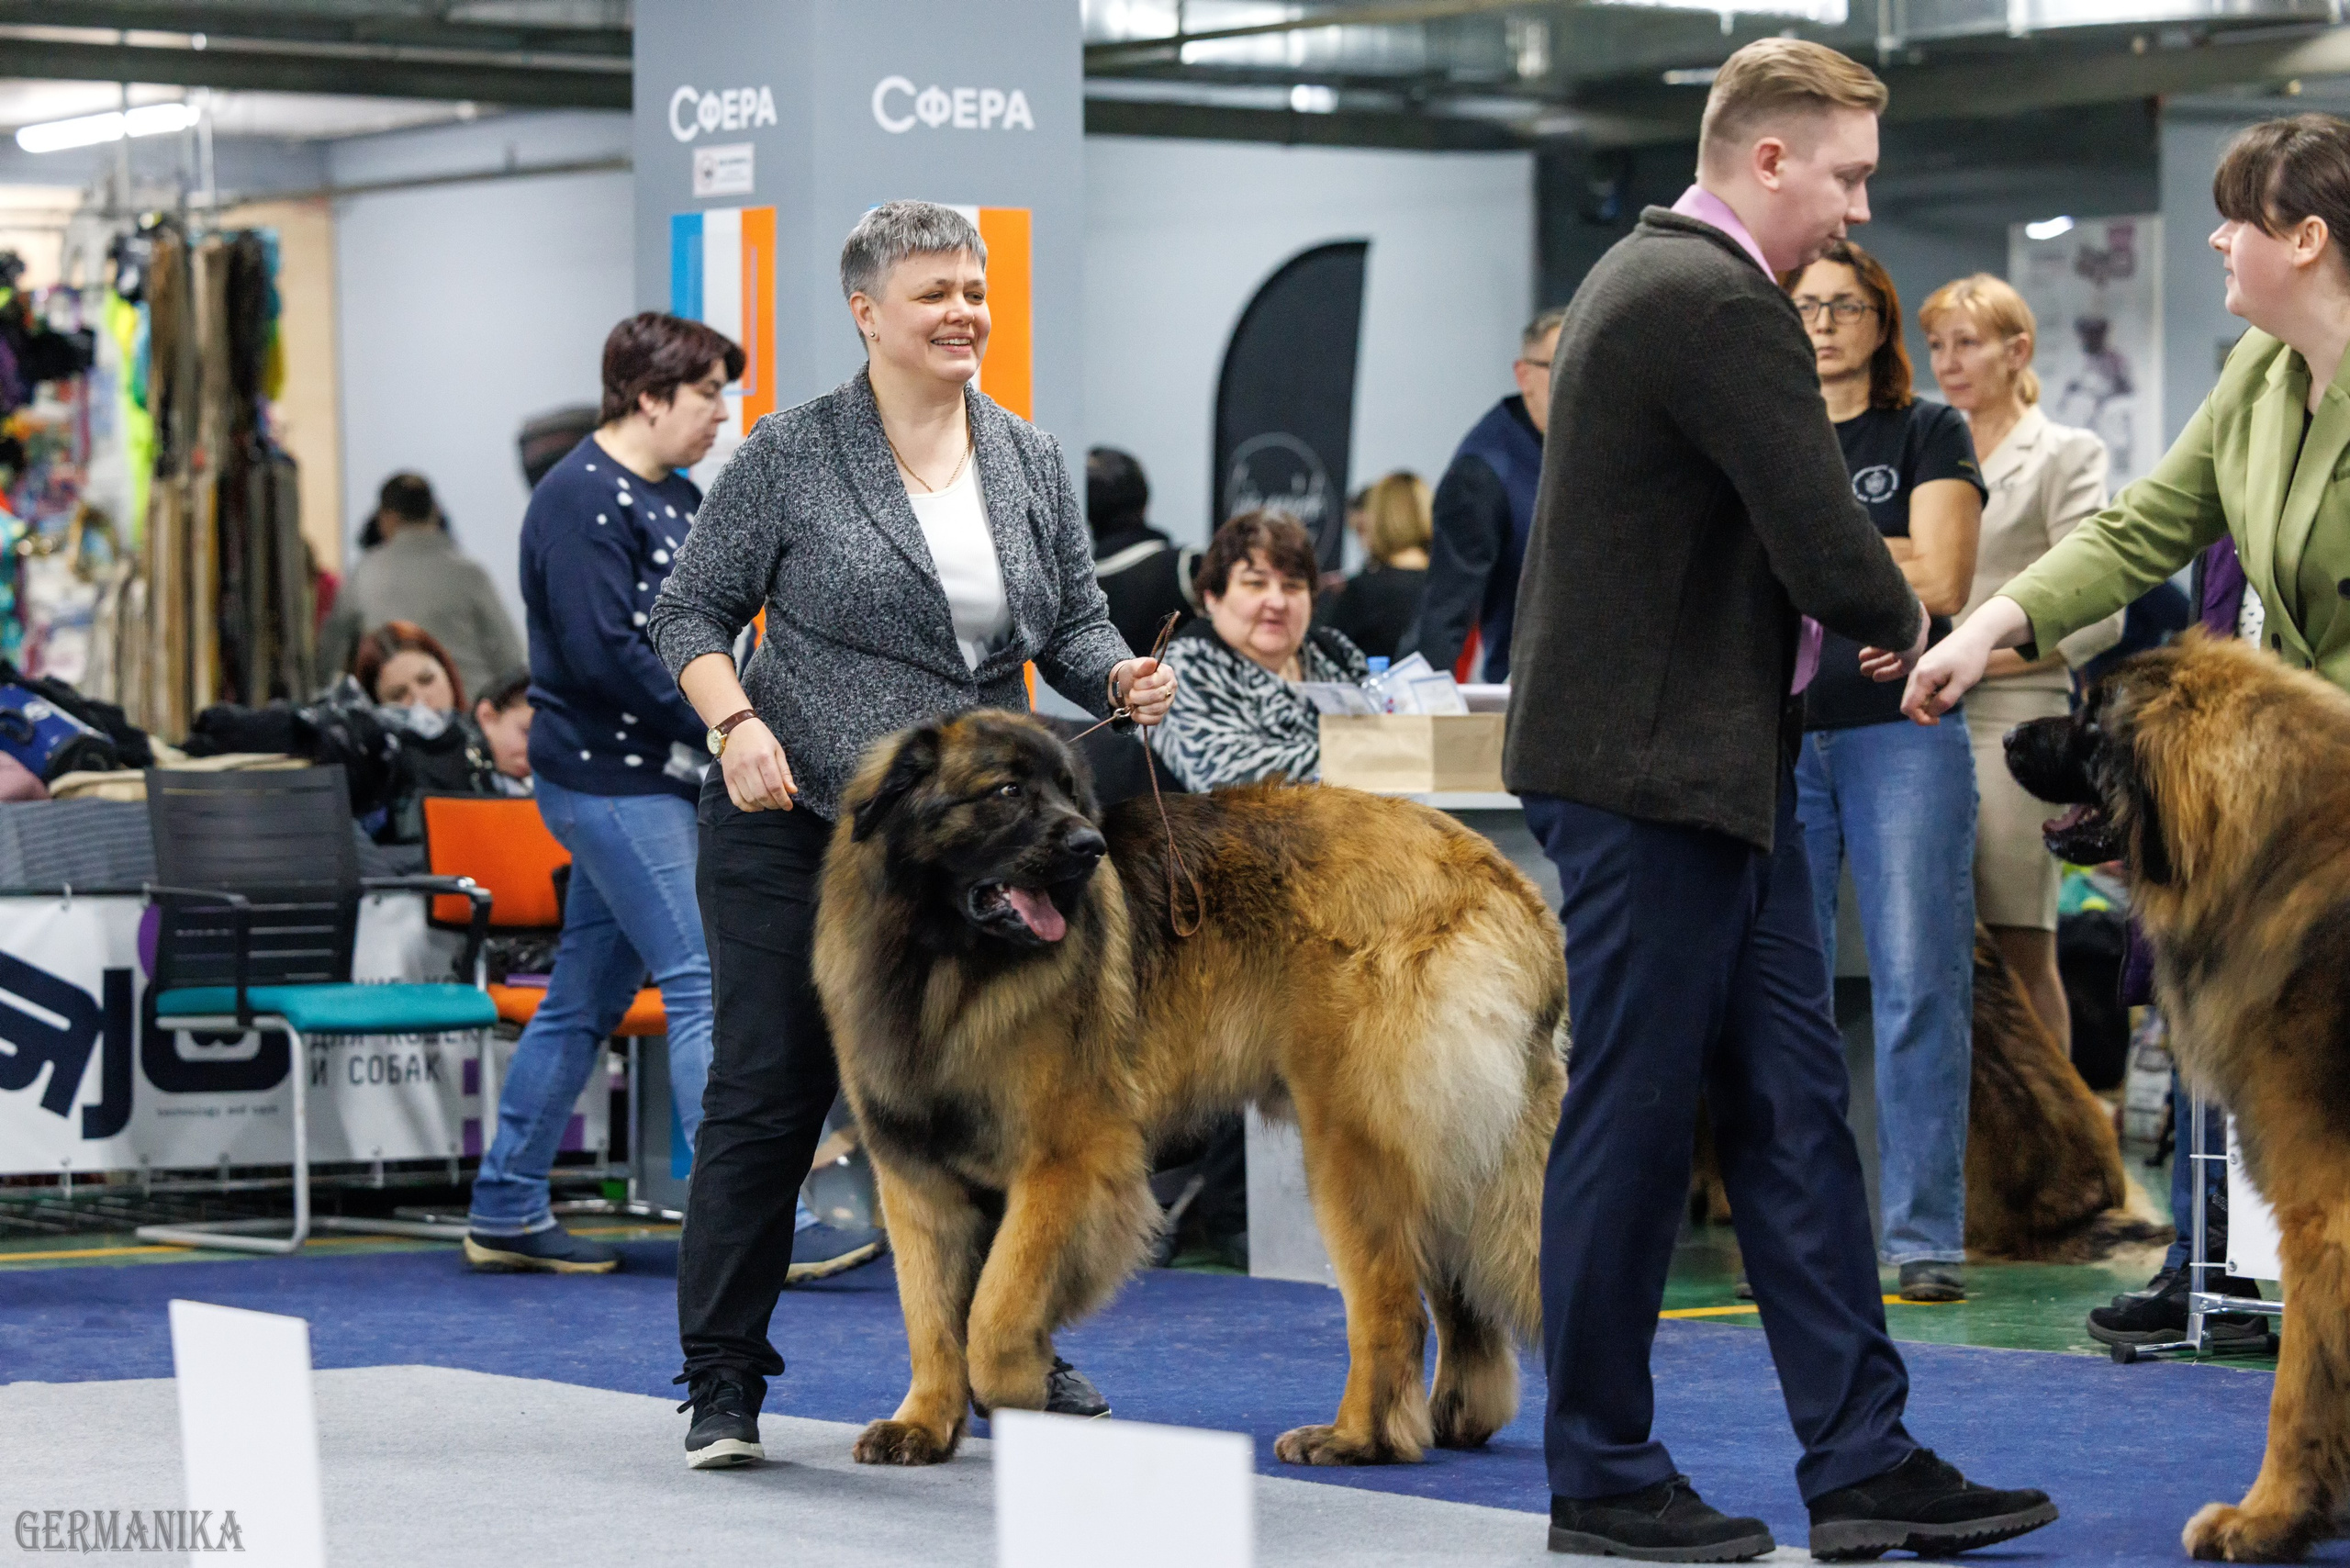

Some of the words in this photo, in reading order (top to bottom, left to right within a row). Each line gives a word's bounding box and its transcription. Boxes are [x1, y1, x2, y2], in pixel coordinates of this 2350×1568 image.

[670, 84, 778, 142] СФЕРА
[872, 75, 1035, 134] СФЕРА
[349, 1052, 442, 1085] СОБАК
